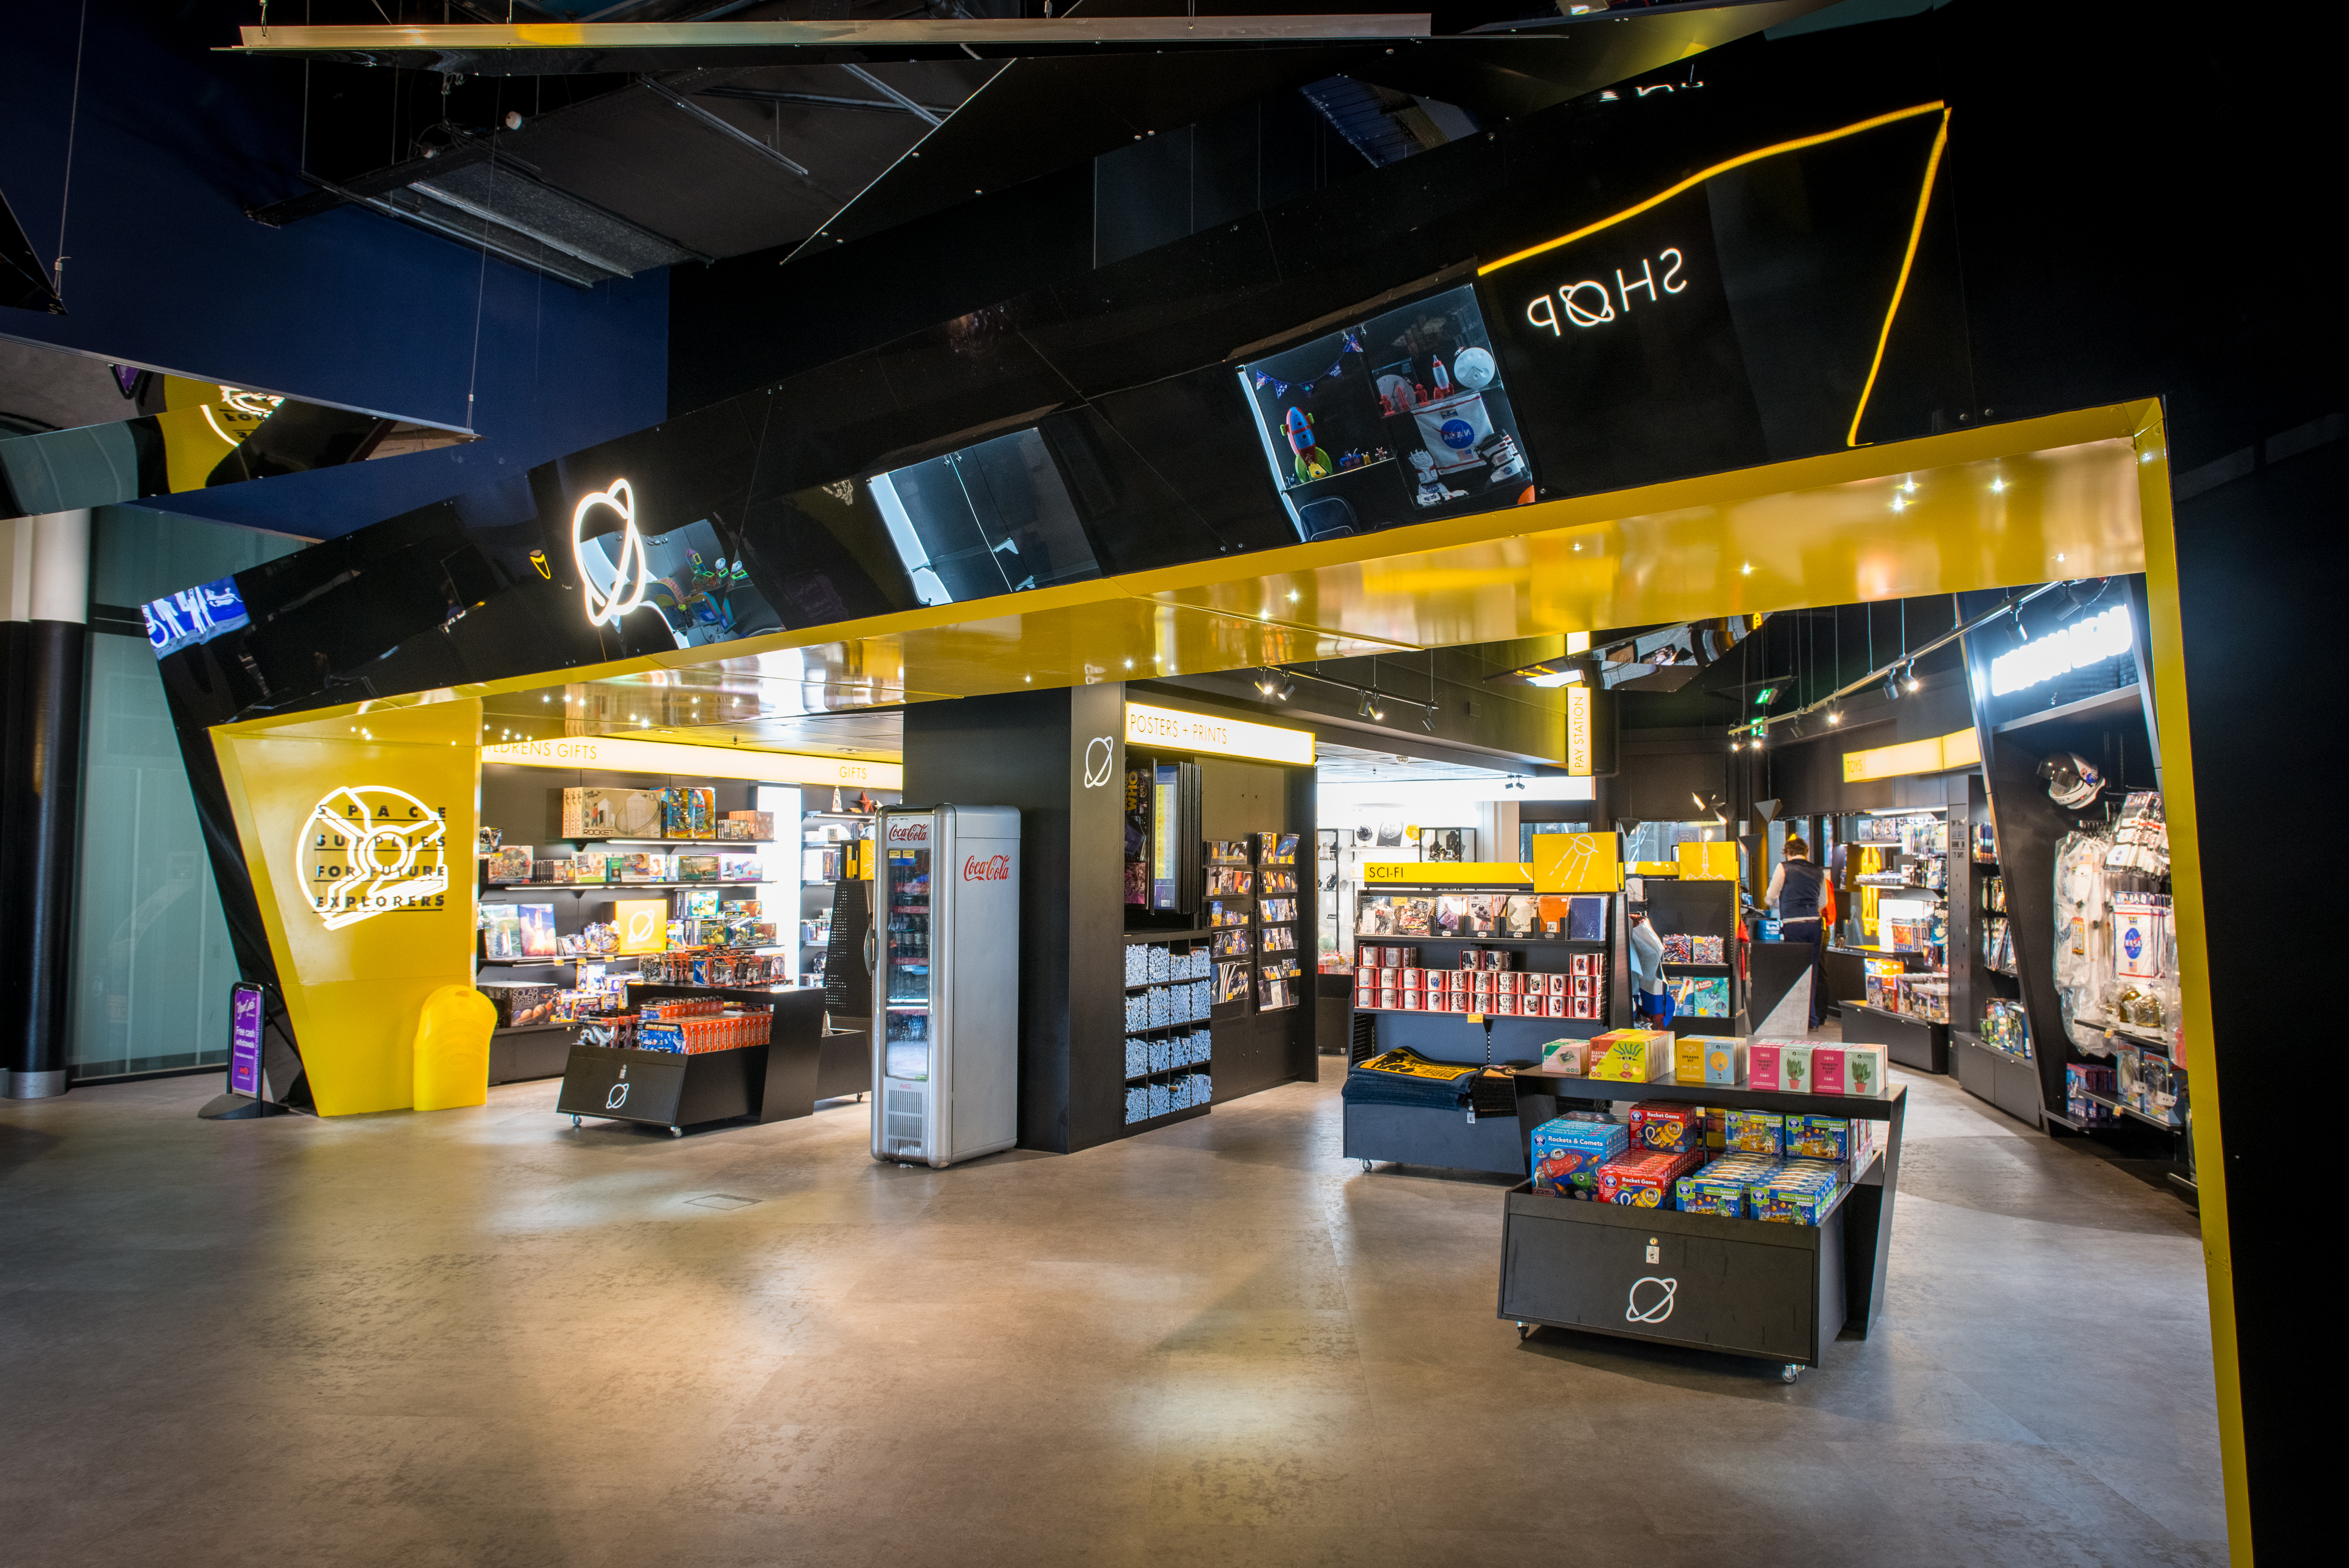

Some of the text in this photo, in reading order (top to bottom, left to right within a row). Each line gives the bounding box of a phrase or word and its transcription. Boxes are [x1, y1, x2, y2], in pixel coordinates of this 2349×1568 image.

[1130, 714, 1227, 744] POSTERS + PRINTS
[1574, 696, 1584, 768] PAY STATION
[557, 743, 597, 759] GIFTS
[839, 766, 867, 779] GIFTS
[1846, 759, 1863, 773] TOYS
[1128, 771, 1138, 810] WHO
[318, 805, 446, 819] SPACE
[583, 829, 614, 837] ROCKET
[889, 824, 928, 842] Coca-Cola
[316, 835, 446, 847] SUPPLIES
[316, 866, 445, 877] FOR FUTURE
[964, 854, 1011, 881] Coca-Cola
[1369, 867, 1403, 878] SCI-FI
[315, 895, 445, 908] EXPLORERS
[2125, 939, 2142, 948] NASA
[513, 988, 538, 997] SOLAR
[236, 1025, 245, 1037] Free
[1548, 1136, 1572, 1144] Rockets
